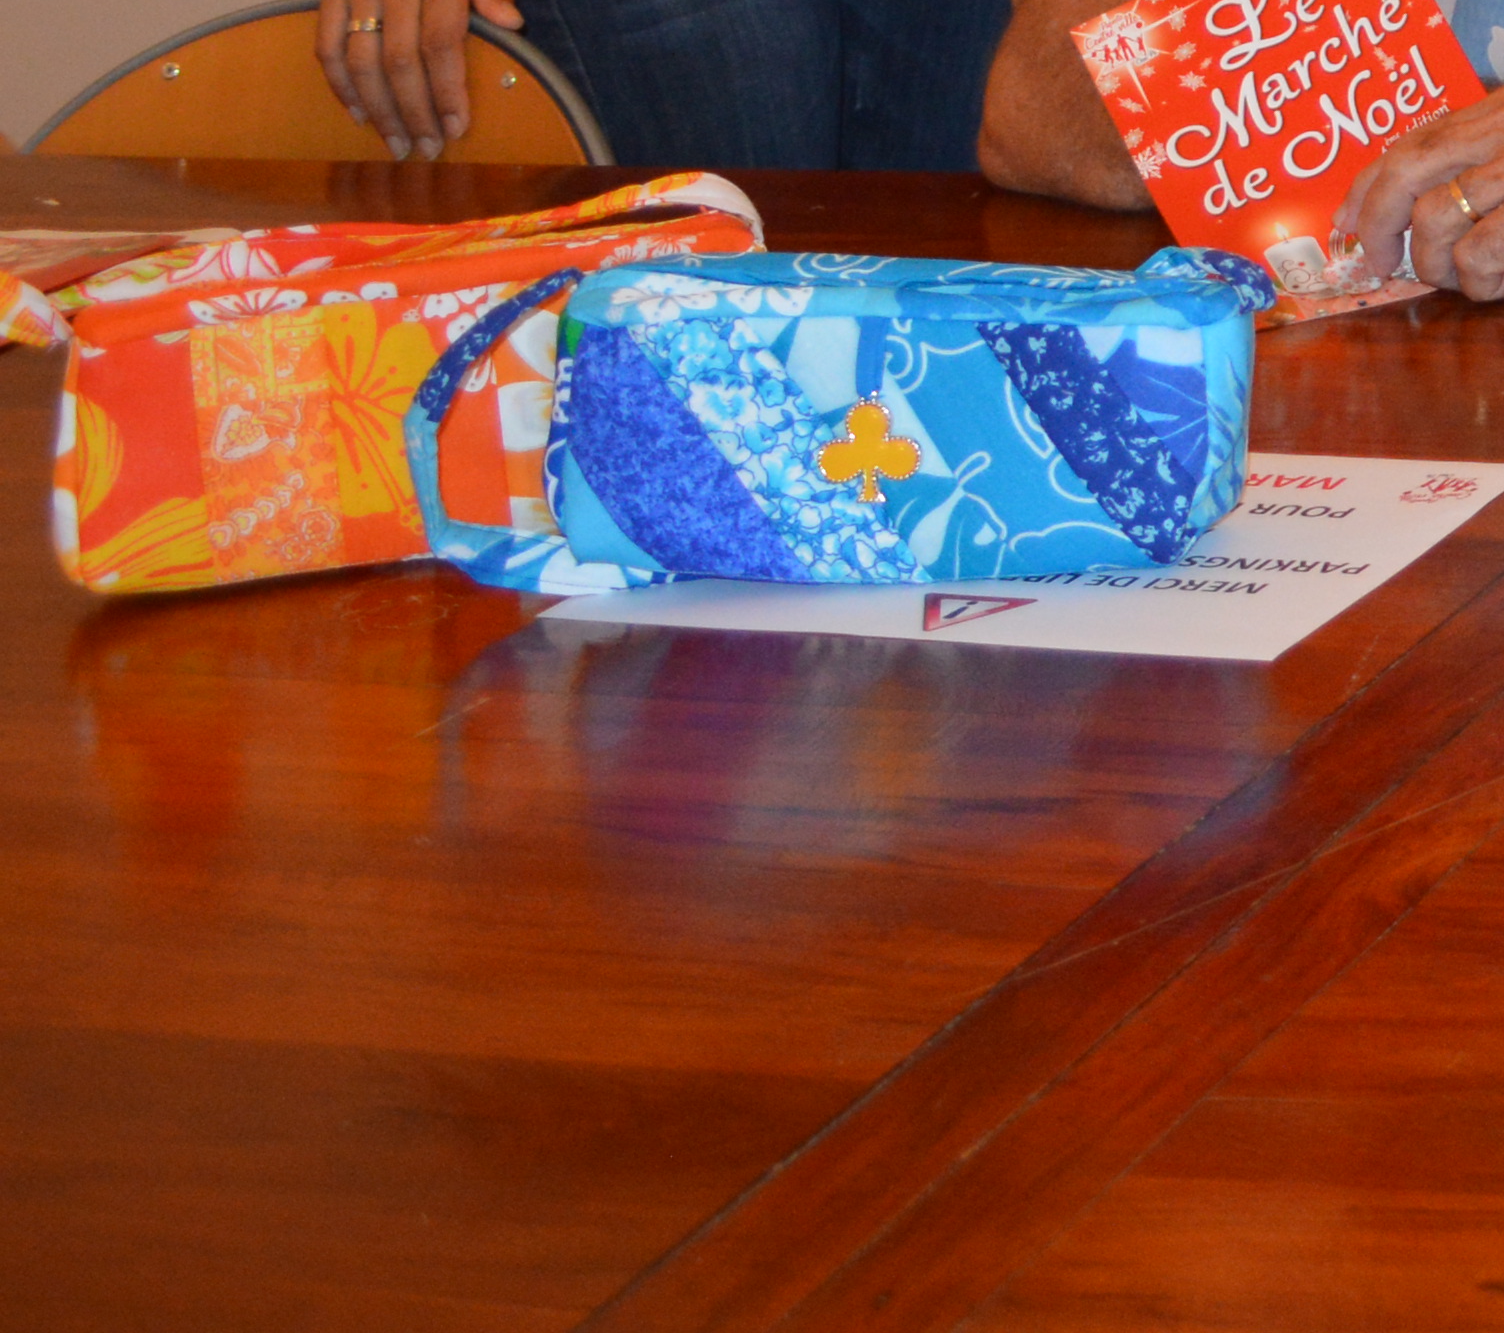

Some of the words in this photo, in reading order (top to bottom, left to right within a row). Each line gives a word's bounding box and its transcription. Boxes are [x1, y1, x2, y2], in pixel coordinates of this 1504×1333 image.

[1202, 159, 1275, 217] de
[1280, 44, 1446, 181] Noël
[1242, 502, 1357, 520] POUR
[1176, 554, 1370, 576] PARKINGS
[1094, 573, 1132, 589] DE
[1145, 576, 1269, 595] MERCI
